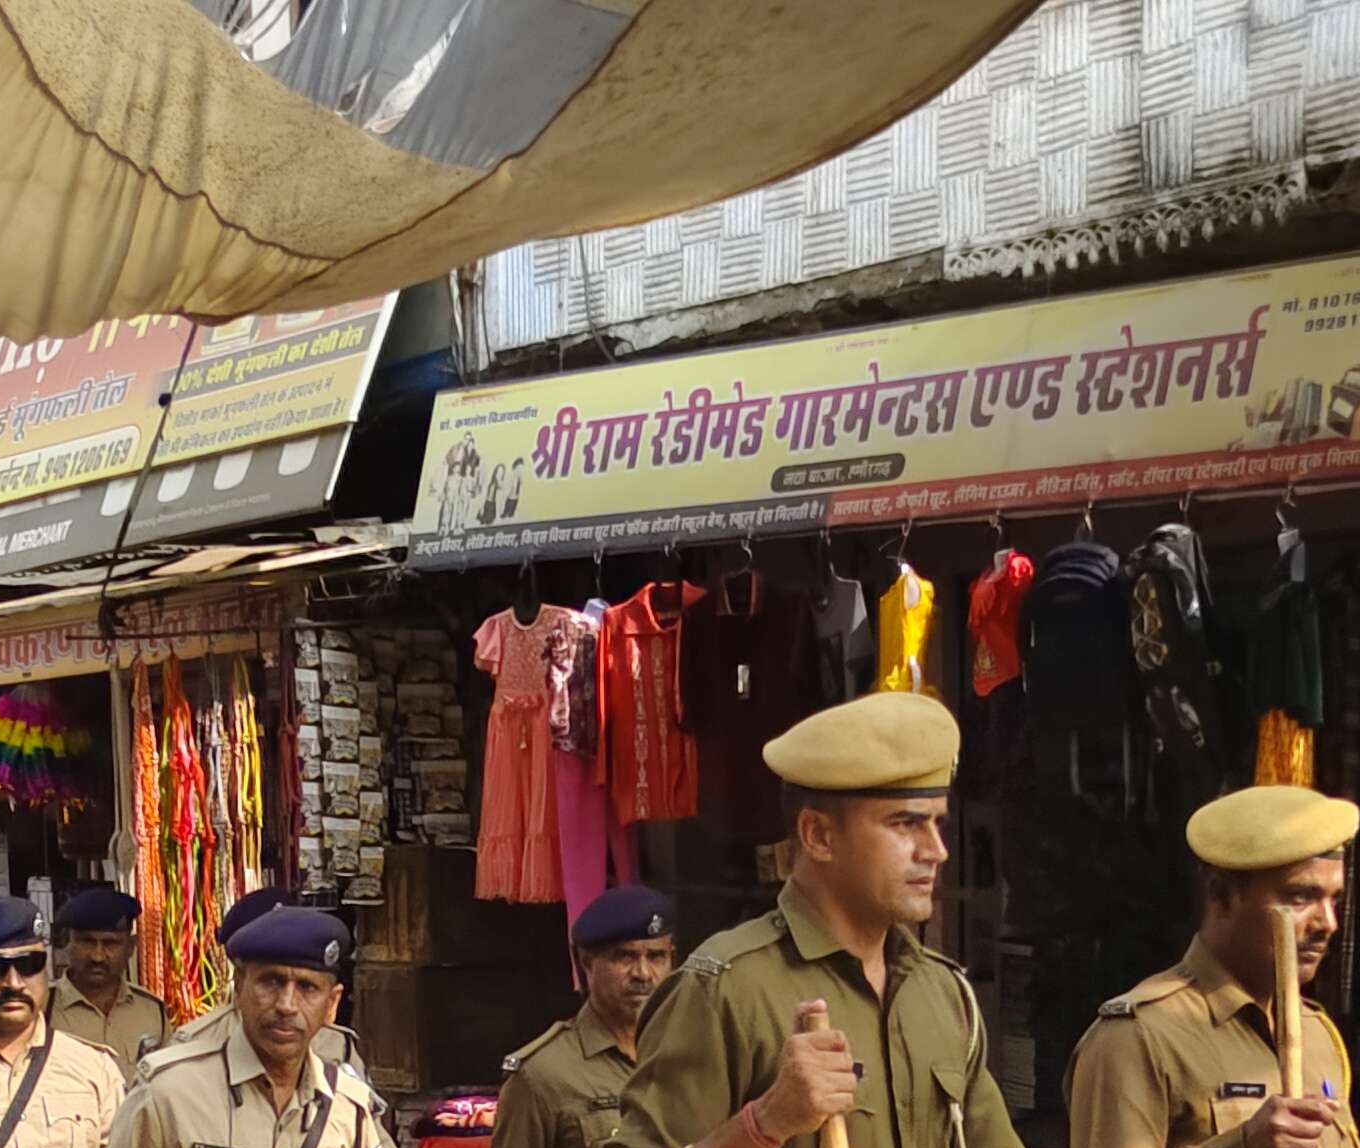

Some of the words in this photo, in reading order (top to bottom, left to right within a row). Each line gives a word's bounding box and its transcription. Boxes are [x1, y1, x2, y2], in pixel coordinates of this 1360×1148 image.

[94, 370, 137, 409] तेल
[530, 405, 582, 479] श्री
[582, 412, 649, 476] राम
[649, 378, 768, 467] रेडीमेड
[974, 356, 1071, 431] एण्ड
[1077, 303, 1270, 412] स्टेशनर्स
[8, 519, 74, 554] MERCHANT
